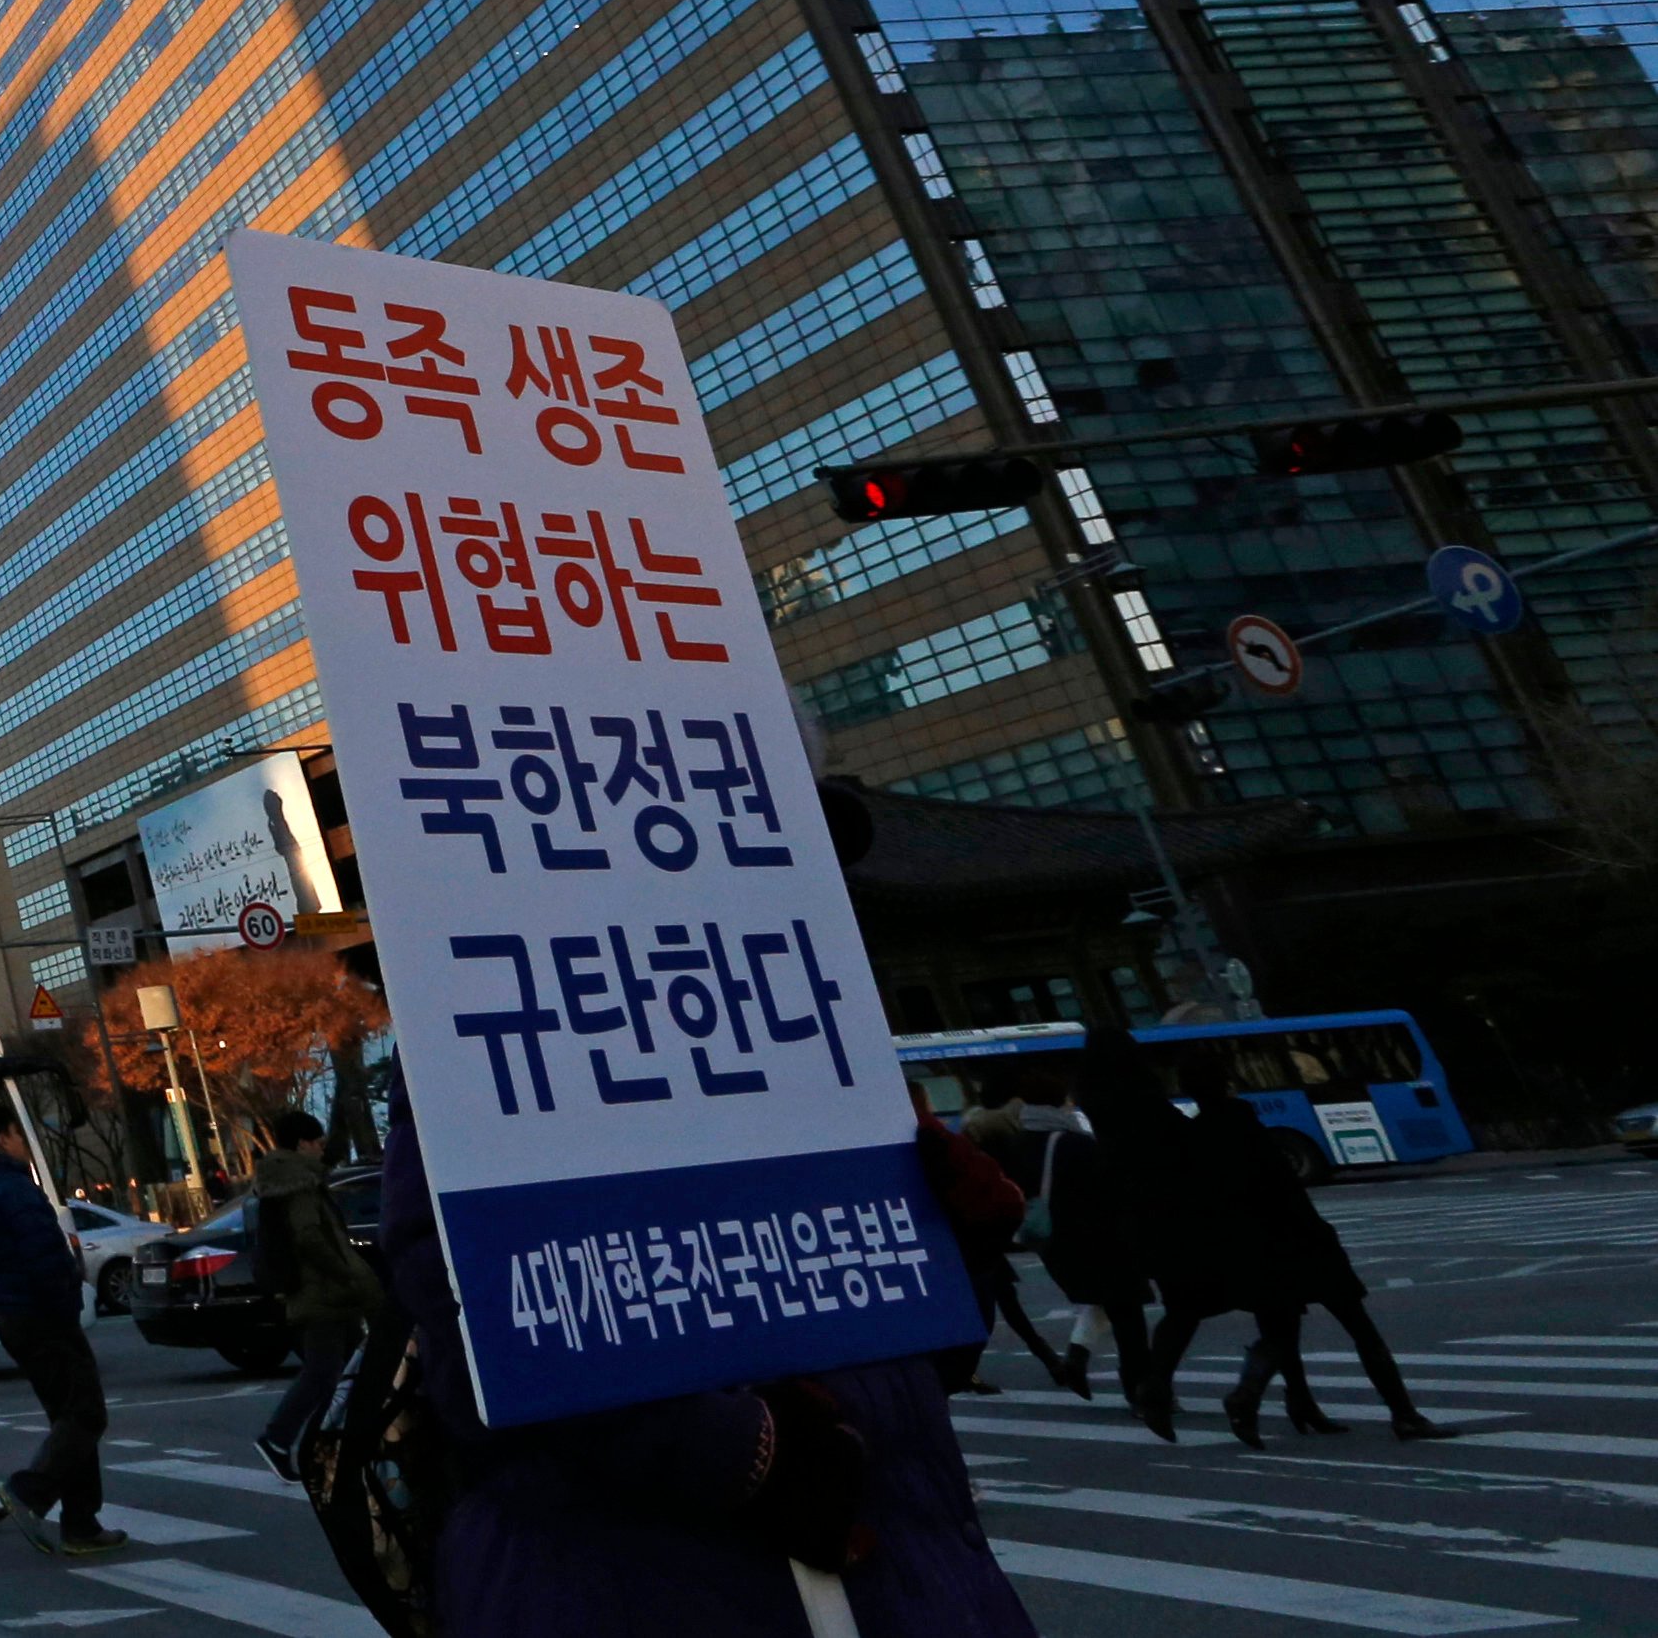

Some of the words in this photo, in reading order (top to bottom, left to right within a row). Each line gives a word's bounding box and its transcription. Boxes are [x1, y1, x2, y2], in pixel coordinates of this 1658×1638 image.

[285, 285, 484, 456] 동족
[505, 321, 686, 476] 생존
[346, 492, 730, 664] 위협하는
[398, 702, 795, 874] 북한정권
[246, 914, 277, 939] 60
[449, 920, 855, 1115] 규탄한다
[510, 1196, 932, 1353] 4대개혁추진국민운동본부
